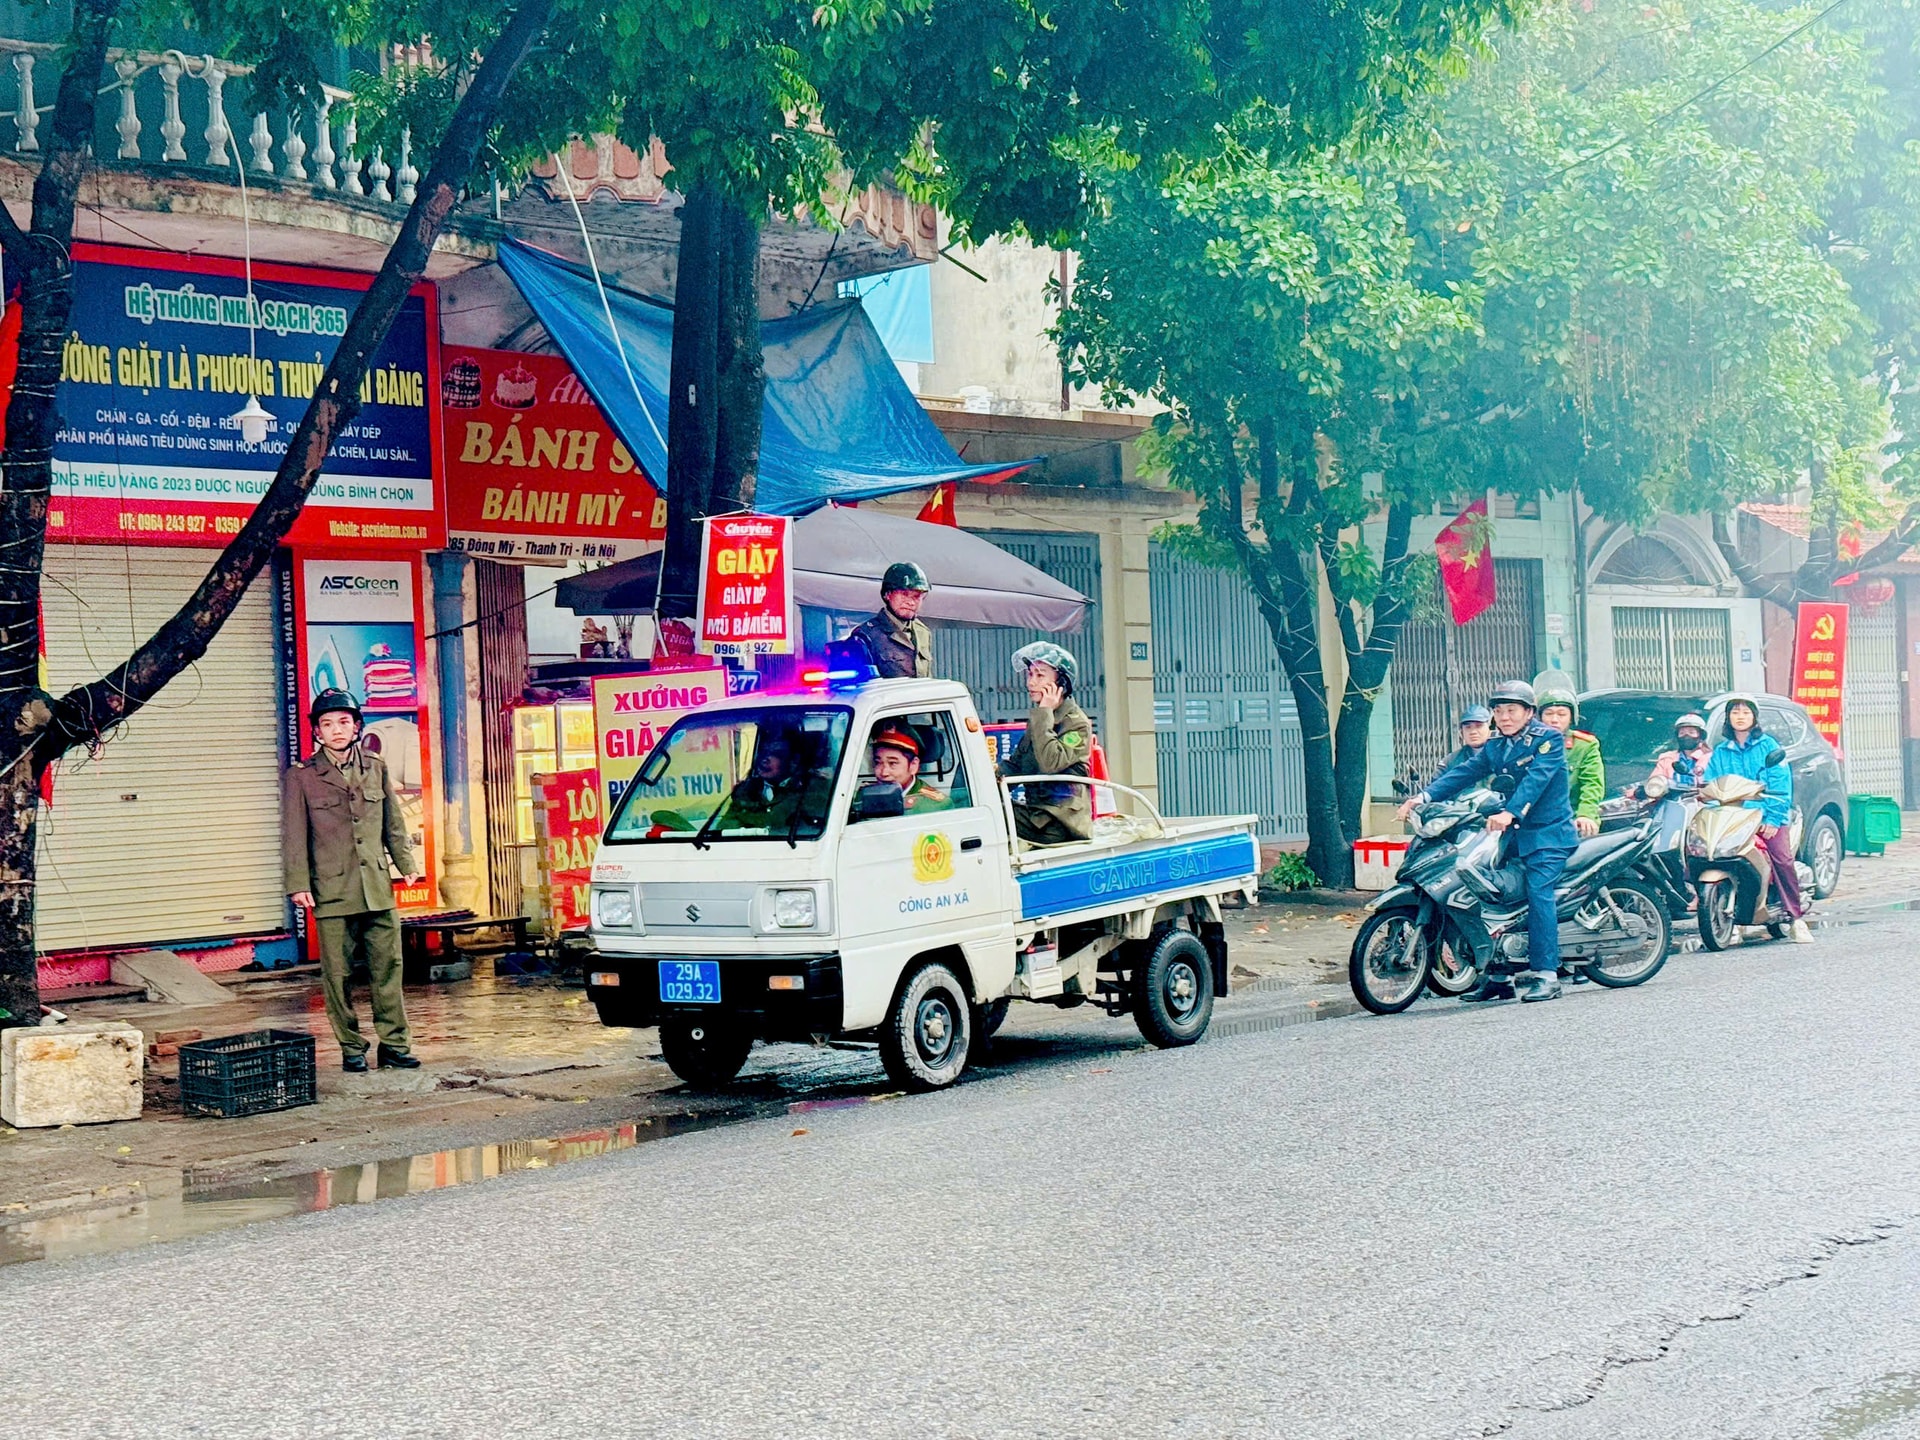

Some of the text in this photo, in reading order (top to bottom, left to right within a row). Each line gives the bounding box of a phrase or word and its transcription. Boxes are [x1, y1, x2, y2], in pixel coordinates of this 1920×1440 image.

[127, 285, 347, 336] HỆ THỐNG NHÀ SẠCH 365
[117, 341, 162, 396] GIẶT
[167, 344, 193, 391] LÀ
[196, 352, 275, 396] PHƯƠNG
[375, 362, 424, 407] ĐĂNG
[135, 412, 151, 425] GA
[160, 410, 179, 427] GỐI
[187, 415, 210, 431] ĐỆM
[55, 429, 86, 443] PHÂN
[89, 427, 115, 445] PHỐI
[117, 432, 148, 447] HÀNG
[150, 433, 175, 448] TIÊU
[177, 435, 207, 450] DÙNG
[209, 440, 233, 452] SINH
[236, 440, 257, 455] HỌC
[260, 441, 288, 455] NƯỚC
[370, 448, 388, 460] LAU
[459, 413, 600, 471] BÁNH
[84, 471, 116, 490] HIỆU
[120, 472, 158, 489] VÀNG
[163, 477, 192, 491] 2023
[195, 477, 231, 495] ĐƯỢC
[236, 478, 270, 494] NGƯỜ
[349, 482, 377, 499] BÌNH
[380, 486, 413, 502] CHỌN
[481, 482, 569, 524] BÁNH
[576, 488, 625, 526] MỲ
[138, 513, 163, 531] 0964
[166, 514, 185, 532] 243
[187, 514, 206, 532] 927
[215, 516, 239, 534] 0359
[525, 541, 556, 556] Thanh
[560, 542, 573, 556] Trì
[582, 543, 596, 557] Hà
[598, 544, 616, 560] Nội
[717, 543, 778, 579] GIẶT
[723, 583, 752, 605] GIÀY
[706, 614, 729, 636] MŨ
[754, 642, 774, 653] 927
[730, 674, 758, 691] 277
[614, 684, 707, 711] XƯỞNG
[566, 778, 597, 821] LÒ
[401, 889, 429, 902] NGAY
[898, 888, 969, 913] CÔNG AN XÃ
[676, 964, 702, 981] 29A
[667, 982, 714, 1000] 029.32
